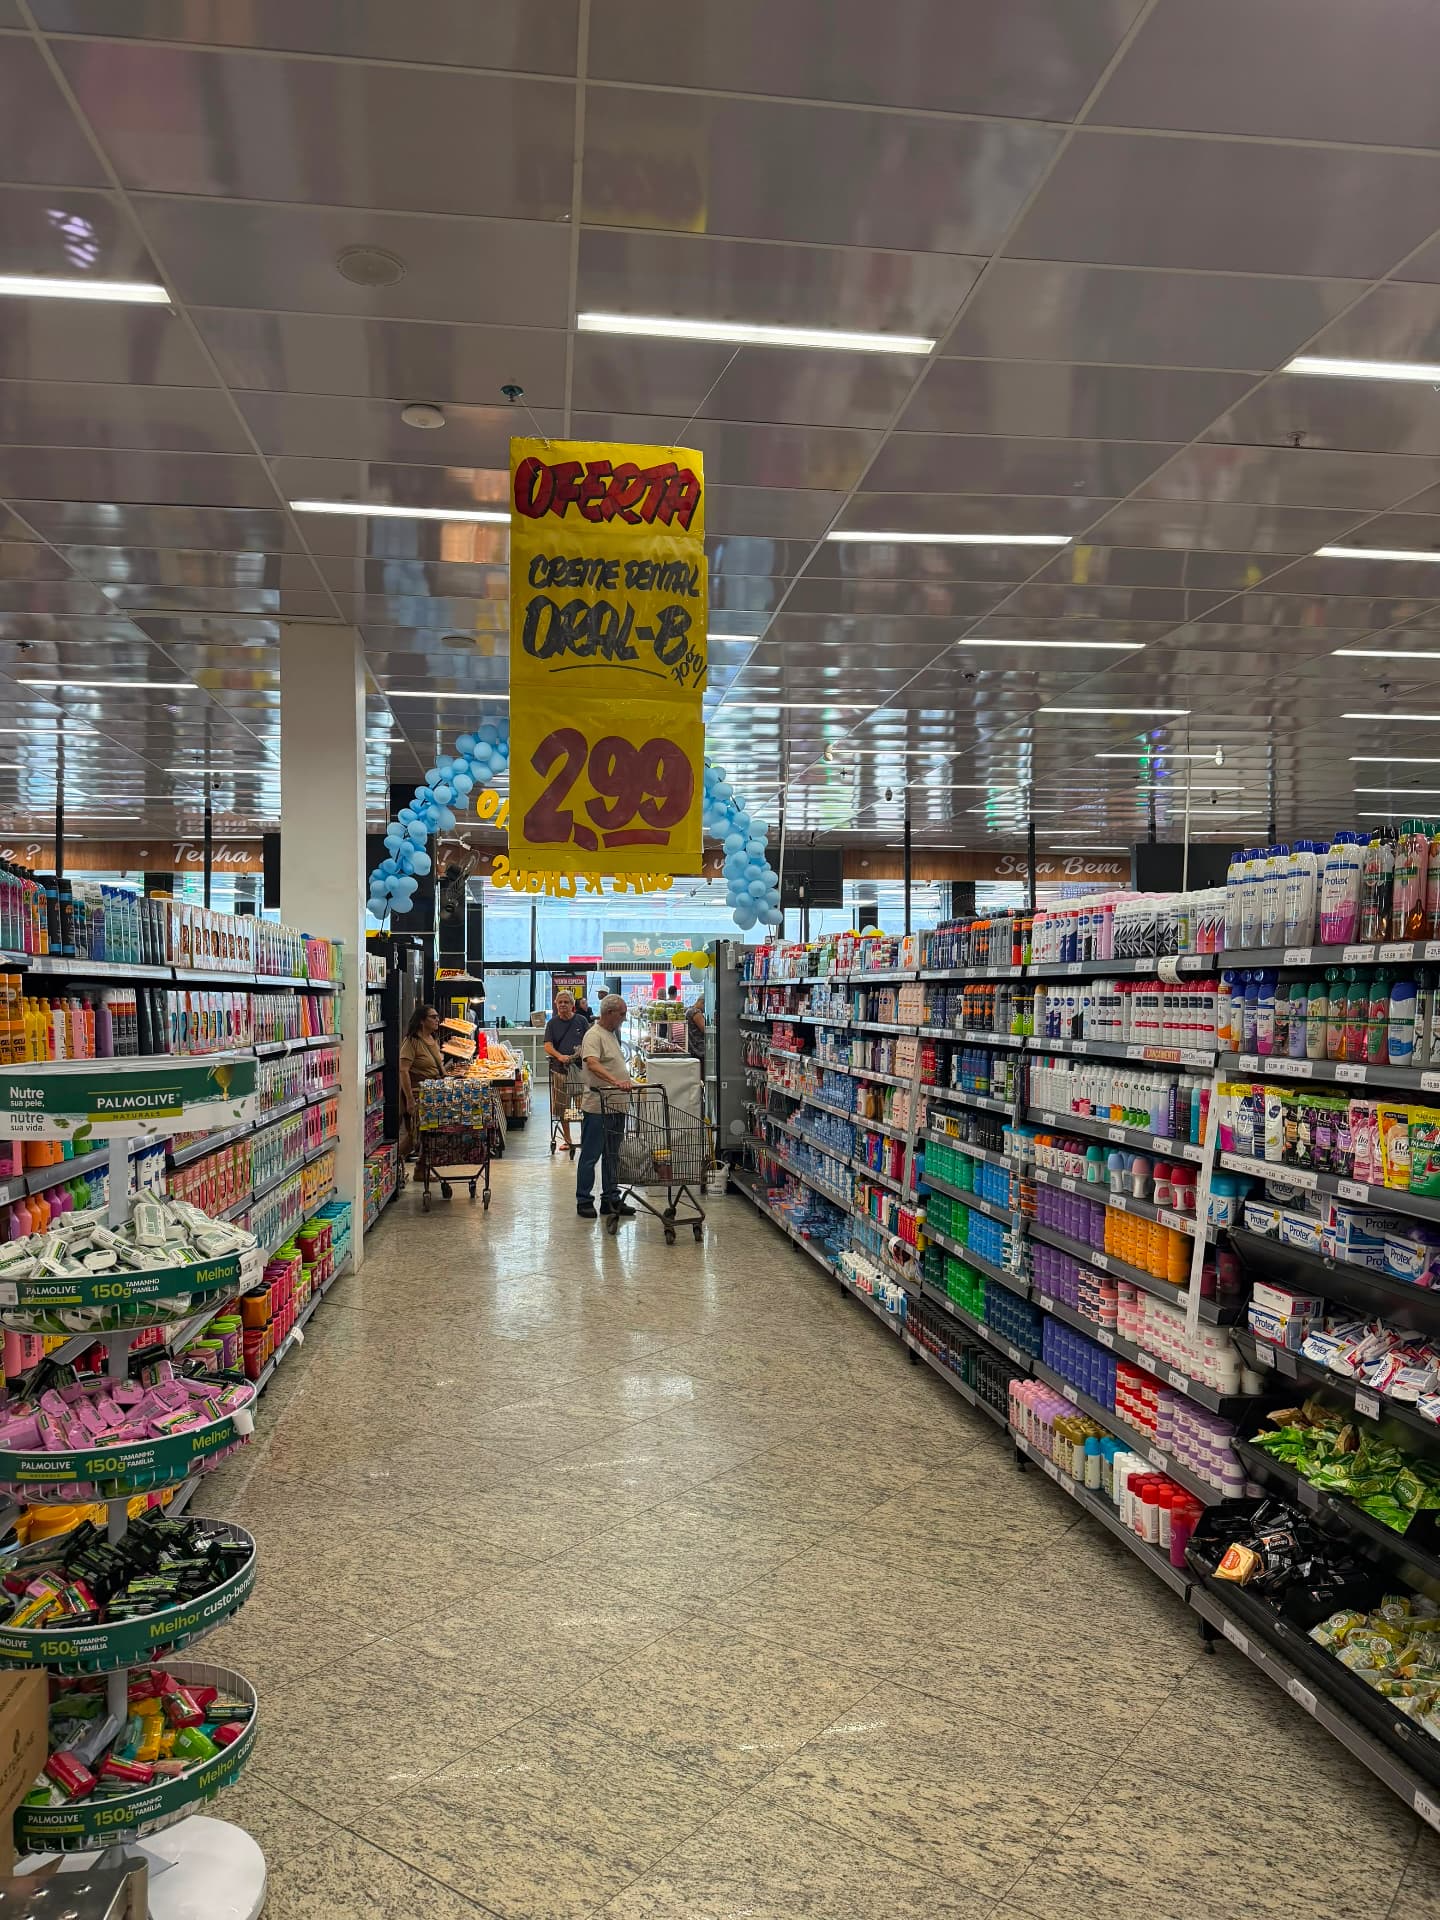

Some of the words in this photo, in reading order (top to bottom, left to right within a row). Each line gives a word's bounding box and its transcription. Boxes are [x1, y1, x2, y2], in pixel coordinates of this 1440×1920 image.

[514, 456, 701, 531] OFERTA
[528, 553, 619, 591] CREME
[625, 556, 700, 597] DENTAL
[522, 595, 692, 666] ORAL-B
[1062, 857, 1122, 875] Bem
[10, 1087, 45, 1099] Nutre
[97, 1093, 175, 1108] PALMOLIVE
[25, 1099, 45, 1108] pele,
[10, 1112, 44, 1123] nutre
[113, 1111, 161, 1120] NATURALS
[26, 1123, 46, 1132] vida.
[1250, 1213, 1270, 1227] Protex
[1365, 1217, 1400, 1230] Protex
[1289, 1224, 1310, 1241] Protex
[1390, 1249, 1412, 1265] Protex
[125, 1278, 160, 1287] TAMANHO
[196, 1265, 235, 1284] Melhor
[26, 1285, 77, 1295] PALMOLIVE
[91, 1283, 132, 1299] 150g
[1255, 1315, 1275, 1332] Protex
[1309, 1341, 1329, 1355] Protex
[1373, 1361, 1389, 1381] Protex
[192, 1428, 231, 1450] Melhor
[120, 1450, 155, 1462] TAMANHO
[21, 1460, 71, 1470] PALMOLIVE
[85, 1457, 126, 1473] 150g
[150, 1612, 201, 1638] Melhor
[72, 1635, 109, 1645] TAMANHO
[40, 1642, 80, 1658] 150g
[199, 1755, 237, 1789] Melhor
[127, 1795, 163, 1811] TAMANHO
[28, 1814, 80, 1824] PALMOLIVE
[93, 1808, 134, 1826] 150g
